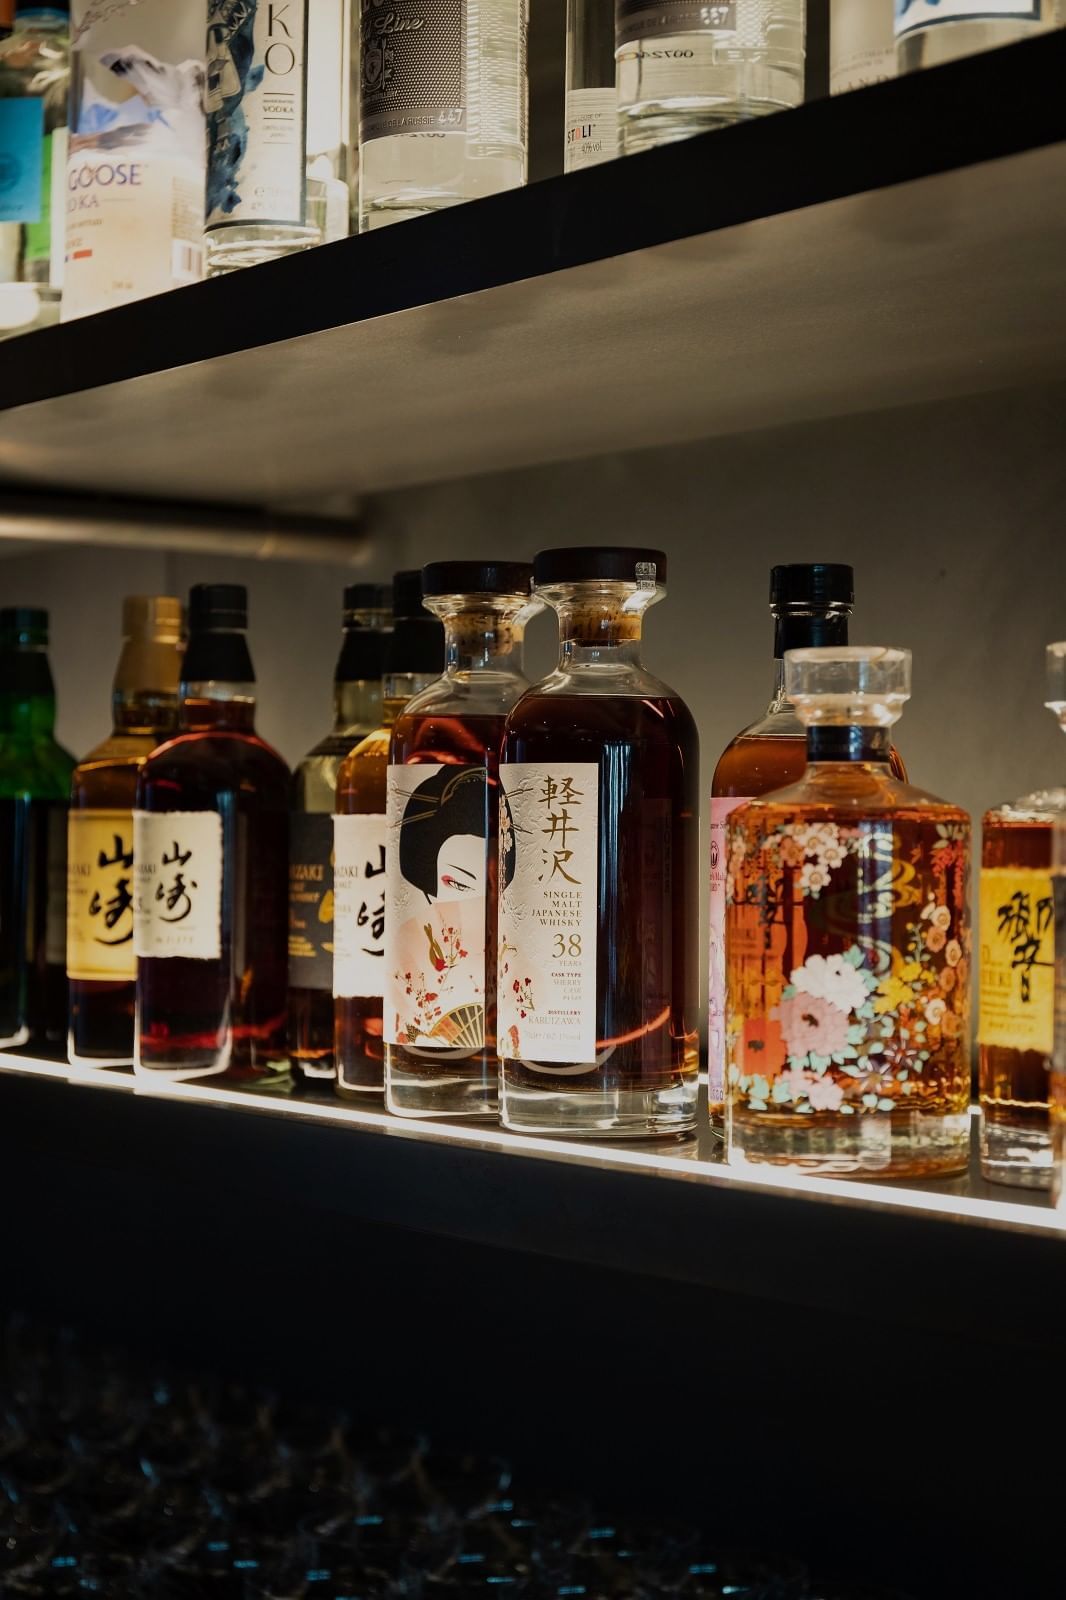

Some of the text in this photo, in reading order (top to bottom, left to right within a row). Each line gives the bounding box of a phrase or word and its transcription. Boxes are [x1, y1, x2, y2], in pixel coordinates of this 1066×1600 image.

[374, 12, 424, 35] Line
[262, 105, 294, 113] VODKA
[567, 123, 592, 144] STOLI
[68, 163, 142, 191] GOOSE
[537, 775, 585, 885] 軽井沢
[543, 891, 583, 899] SINGLE
[551, 900, 583, 908] MALT
[531, 909, 583, 917] JAPANESE
[540, 918, 582, 927] WHISKY
[552, 933, 582, 959] 38
[528, 1015, 581, 1025] KARUIZAWA
